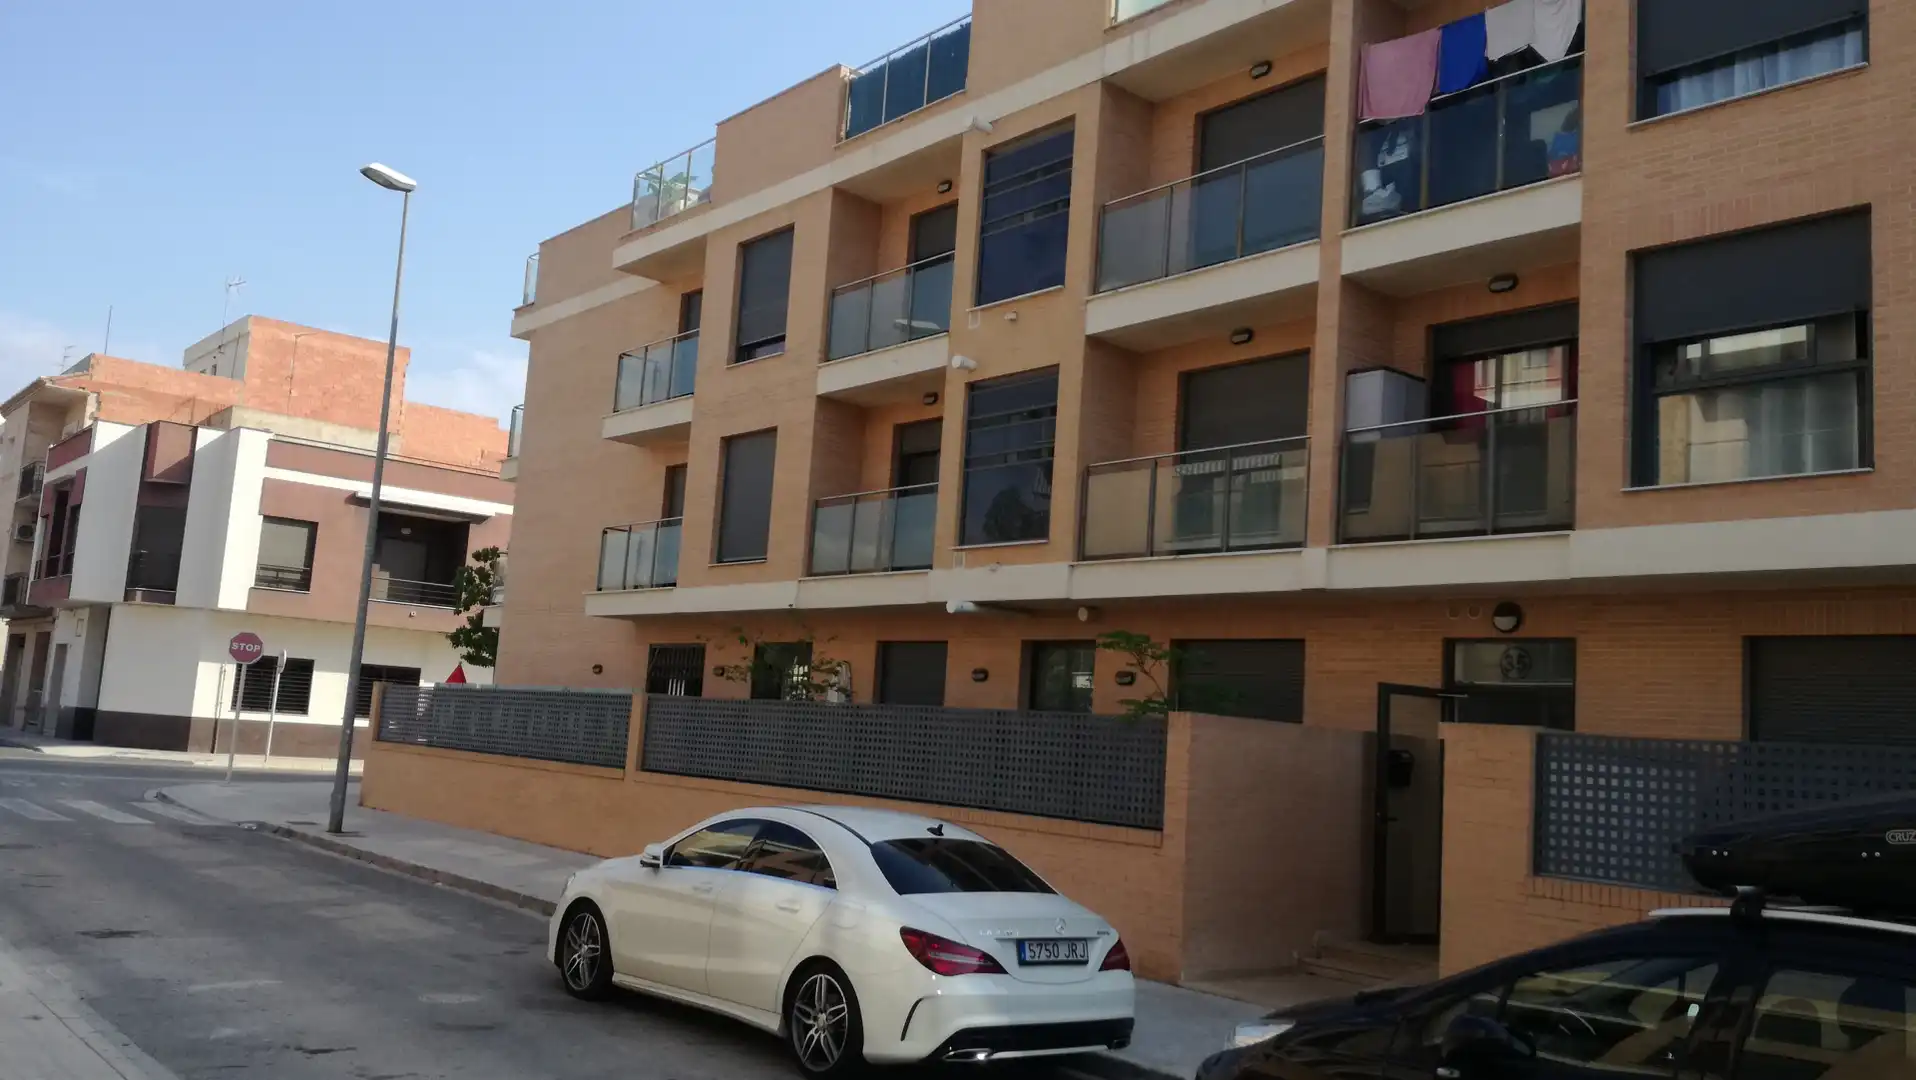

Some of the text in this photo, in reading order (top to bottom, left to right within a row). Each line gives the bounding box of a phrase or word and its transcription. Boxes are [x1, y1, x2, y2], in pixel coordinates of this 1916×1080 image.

[231, 643, 261, 652] STOP
[1888, 832, 1916, 841] CRUZ
[1028, 942, 1060, 959] 5750
[1064, 942, 1086, 959] JRJ
